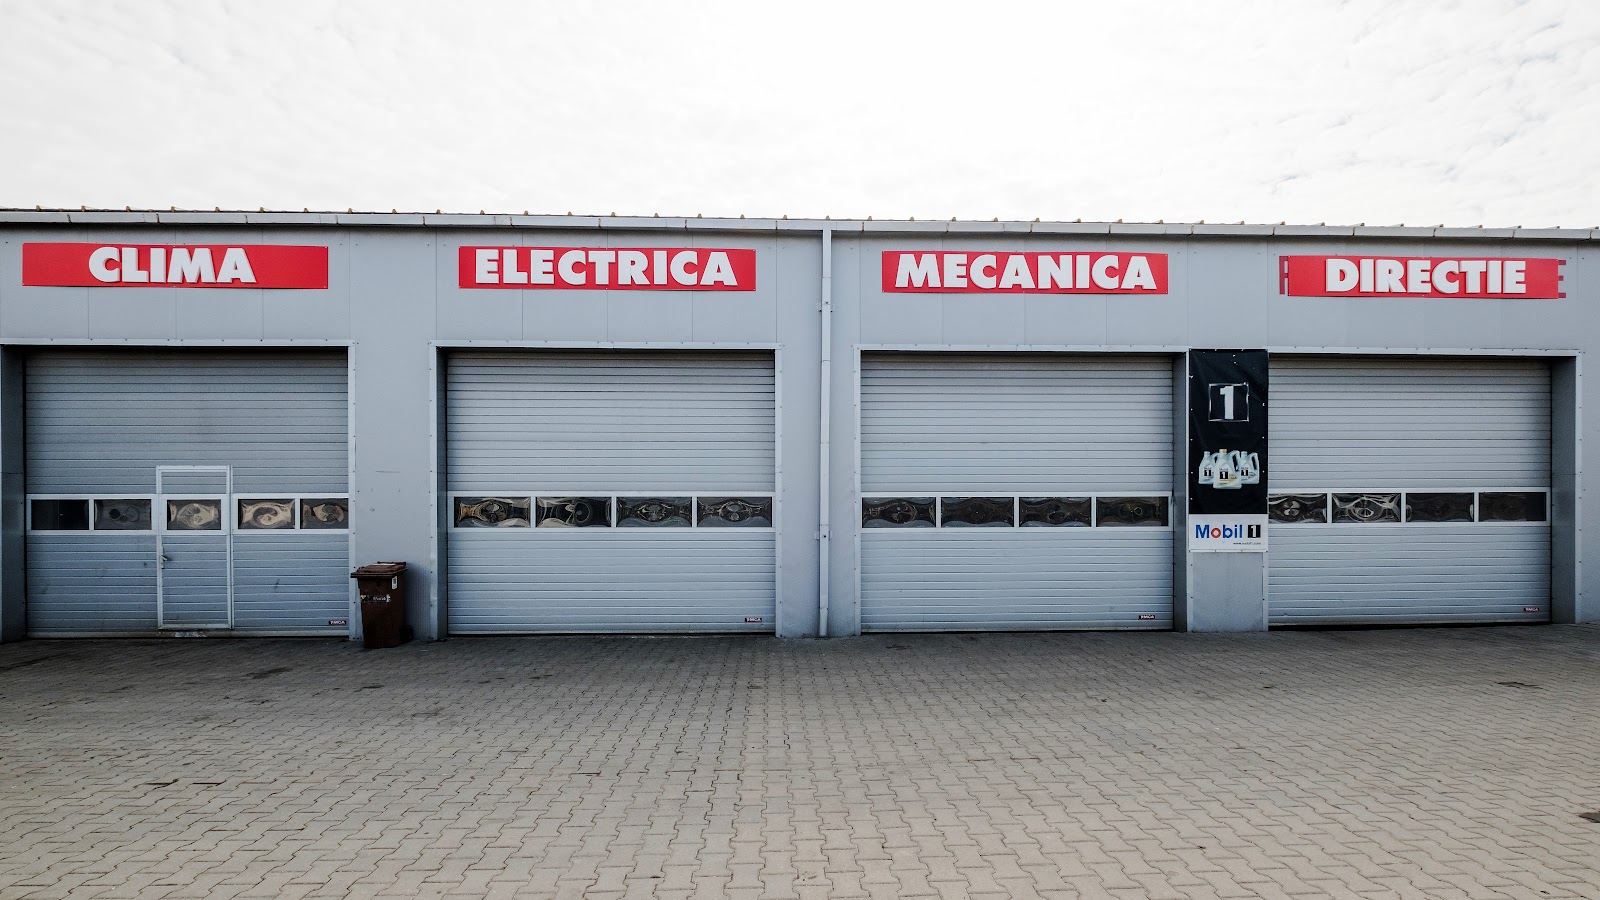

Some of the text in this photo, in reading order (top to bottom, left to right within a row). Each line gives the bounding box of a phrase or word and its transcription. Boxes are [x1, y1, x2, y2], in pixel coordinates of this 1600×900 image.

[88, 246, 257, 283] CLIMA
[475, 248, 739, 286] ELECTRICA
[895, 253, 1157, 290] MECANICA
[1325, 258, 1527, 294] DIRECTIE
[1219, 385, 1234, 420] 1
[1195, 524, 1243, 539] Mobil
